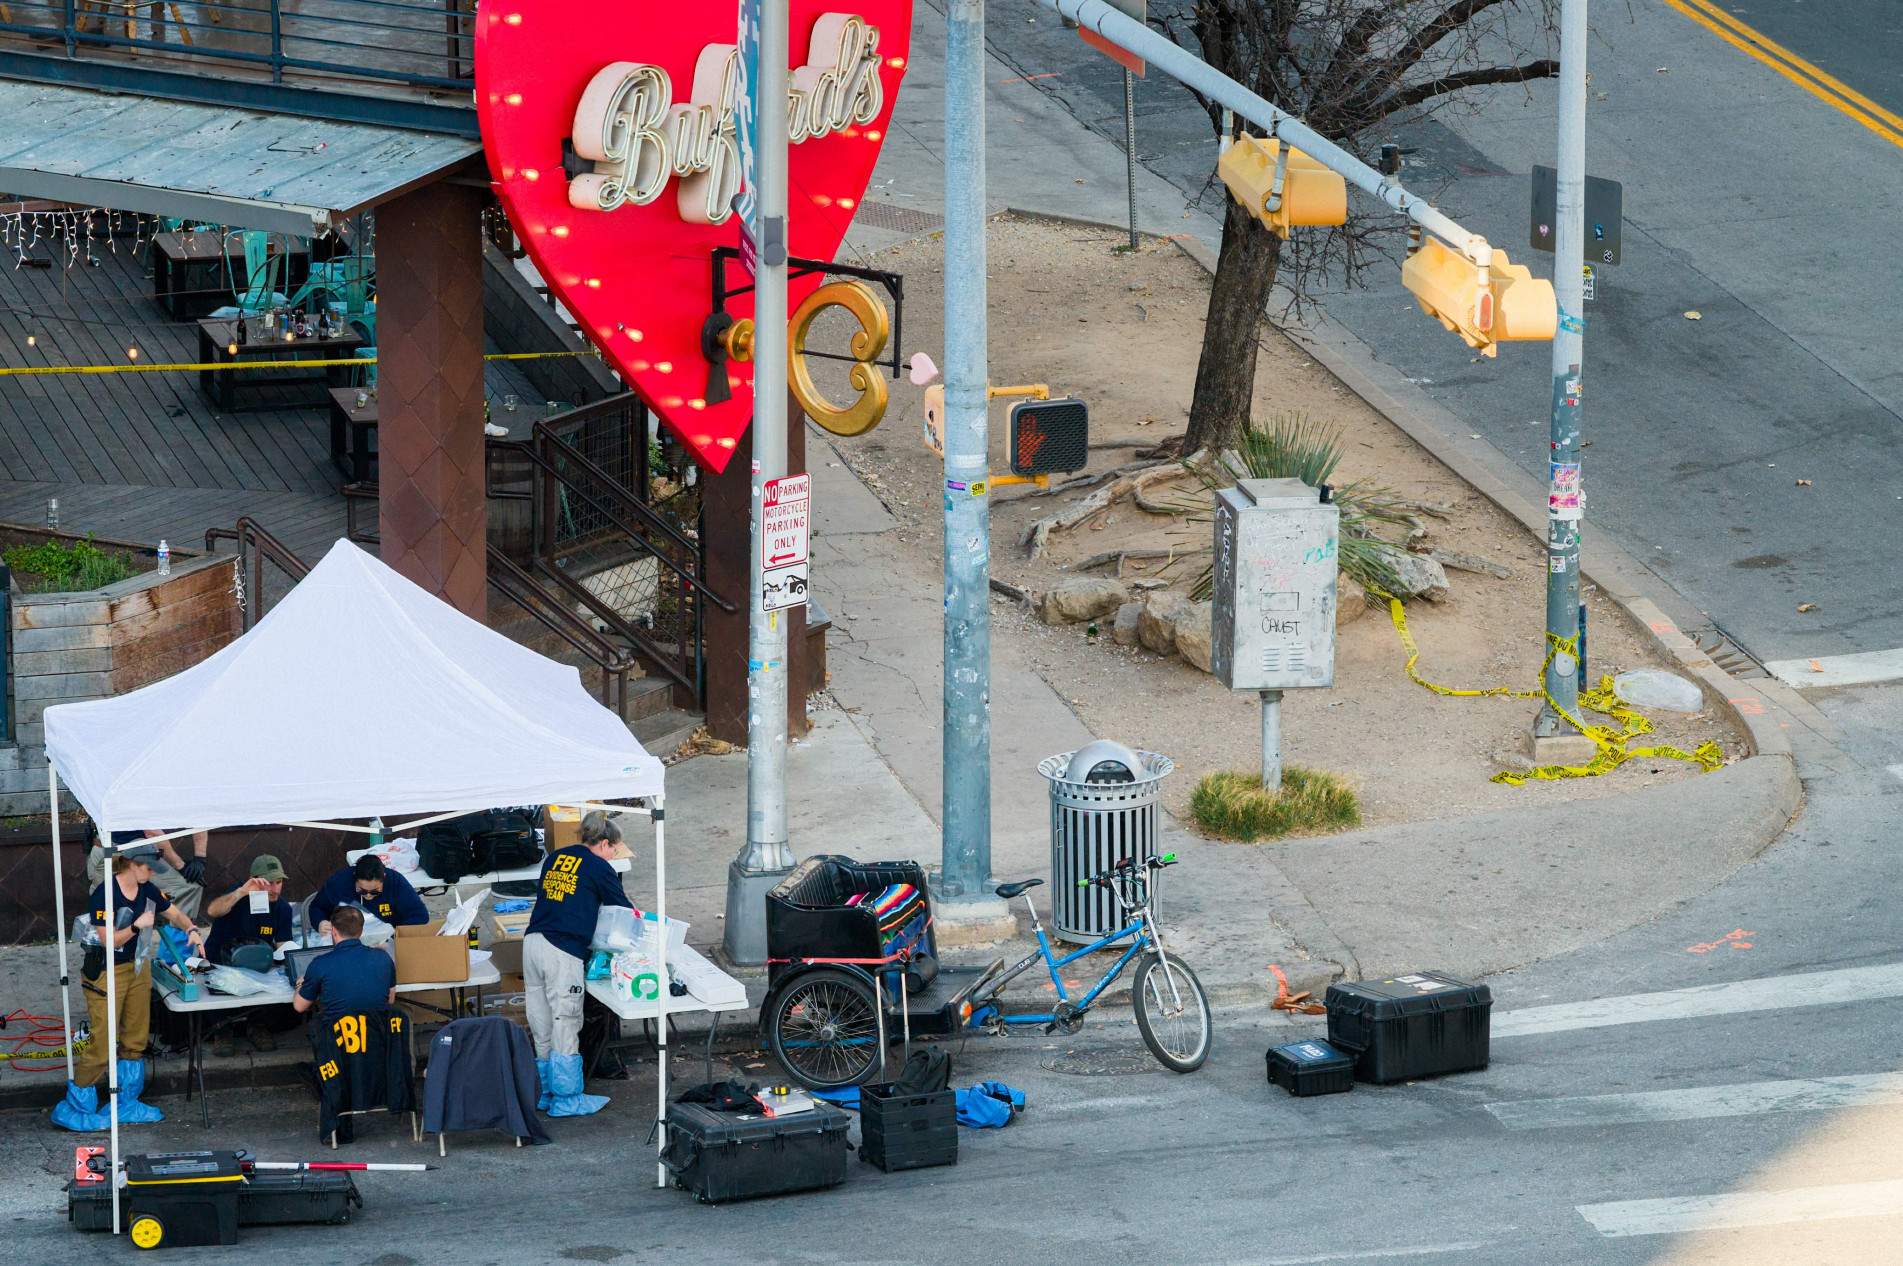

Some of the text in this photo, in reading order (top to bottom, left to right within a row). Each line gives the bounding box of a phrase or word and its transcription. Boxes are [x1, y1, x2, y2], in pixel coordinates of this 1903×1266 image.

[568, 12, 883, 226] Bufrd's
[764, 481, 808, 503] NO PARKING
[765, 501, 807, 519] MOTORCYCLE
[766, 517, 805, 534] PARKING
[774, 535, 797, 550] ONLY
[552, 854, 582, 873] FBI
[545, 871, 578, 885] EVIDENCE
[542, 879, 577, 895] RESPONSE
[546, 889, 565, 902] TEAM
[379, 904, 390, 912] FB
[260, 927, 273, 935] FBI
[333, 1015, 367, 1054] FBI
[319, 1060, 339, 1082] FBI
